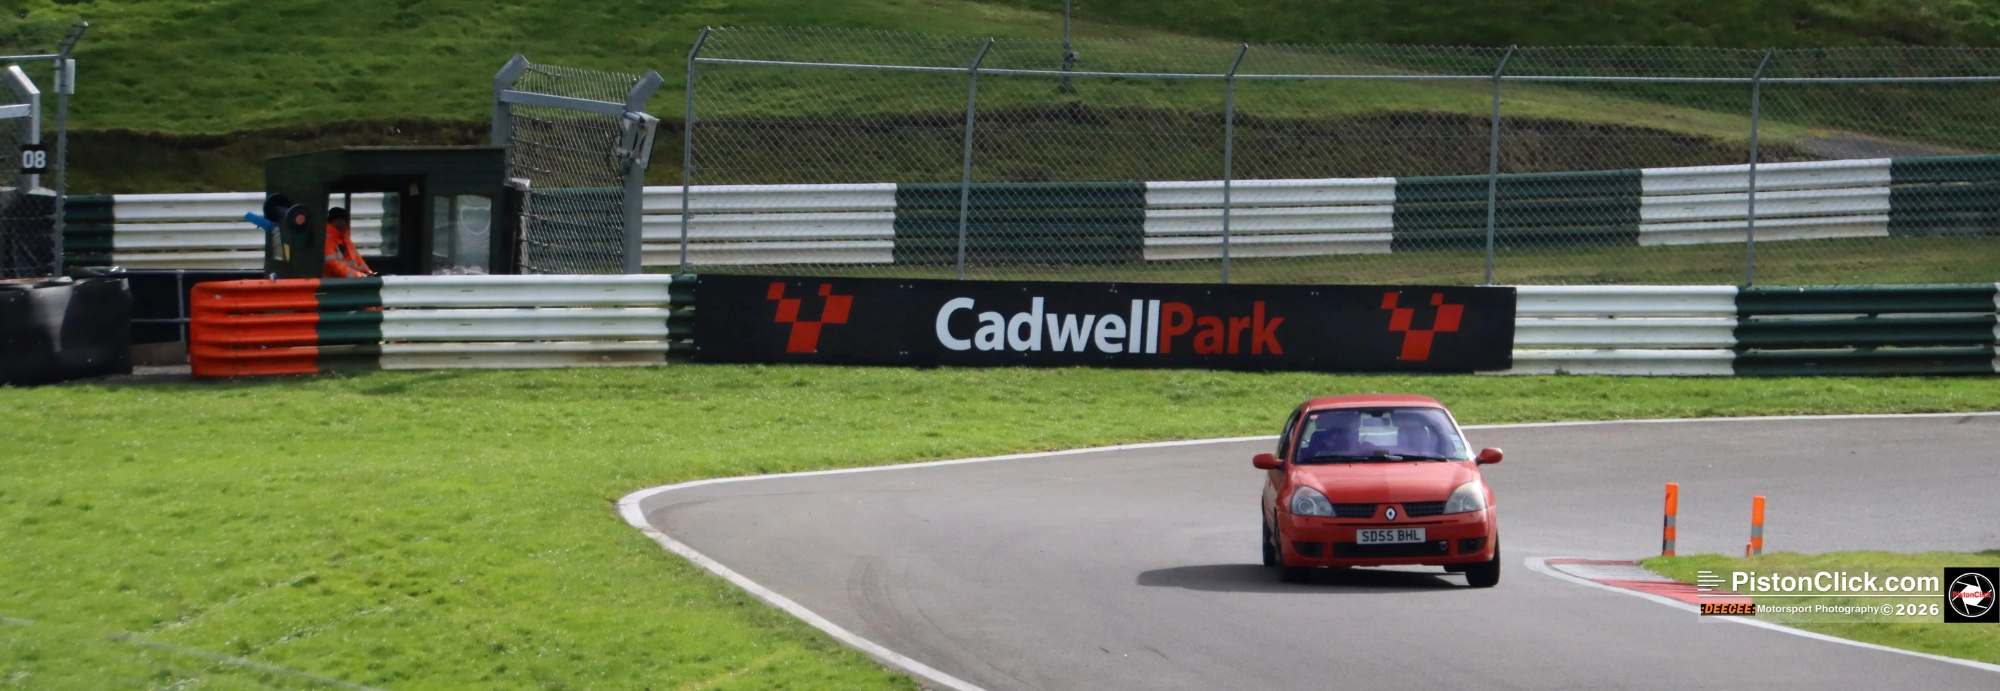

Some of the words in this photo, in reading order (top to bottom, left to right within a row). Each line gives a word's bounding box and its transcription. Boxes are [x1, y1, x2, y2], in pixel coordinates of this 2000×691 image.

[23, 150, 46, 168] 08
[1362, 530, 1394, 542] SD55
[1398, 529, 1421, 541] BHL
